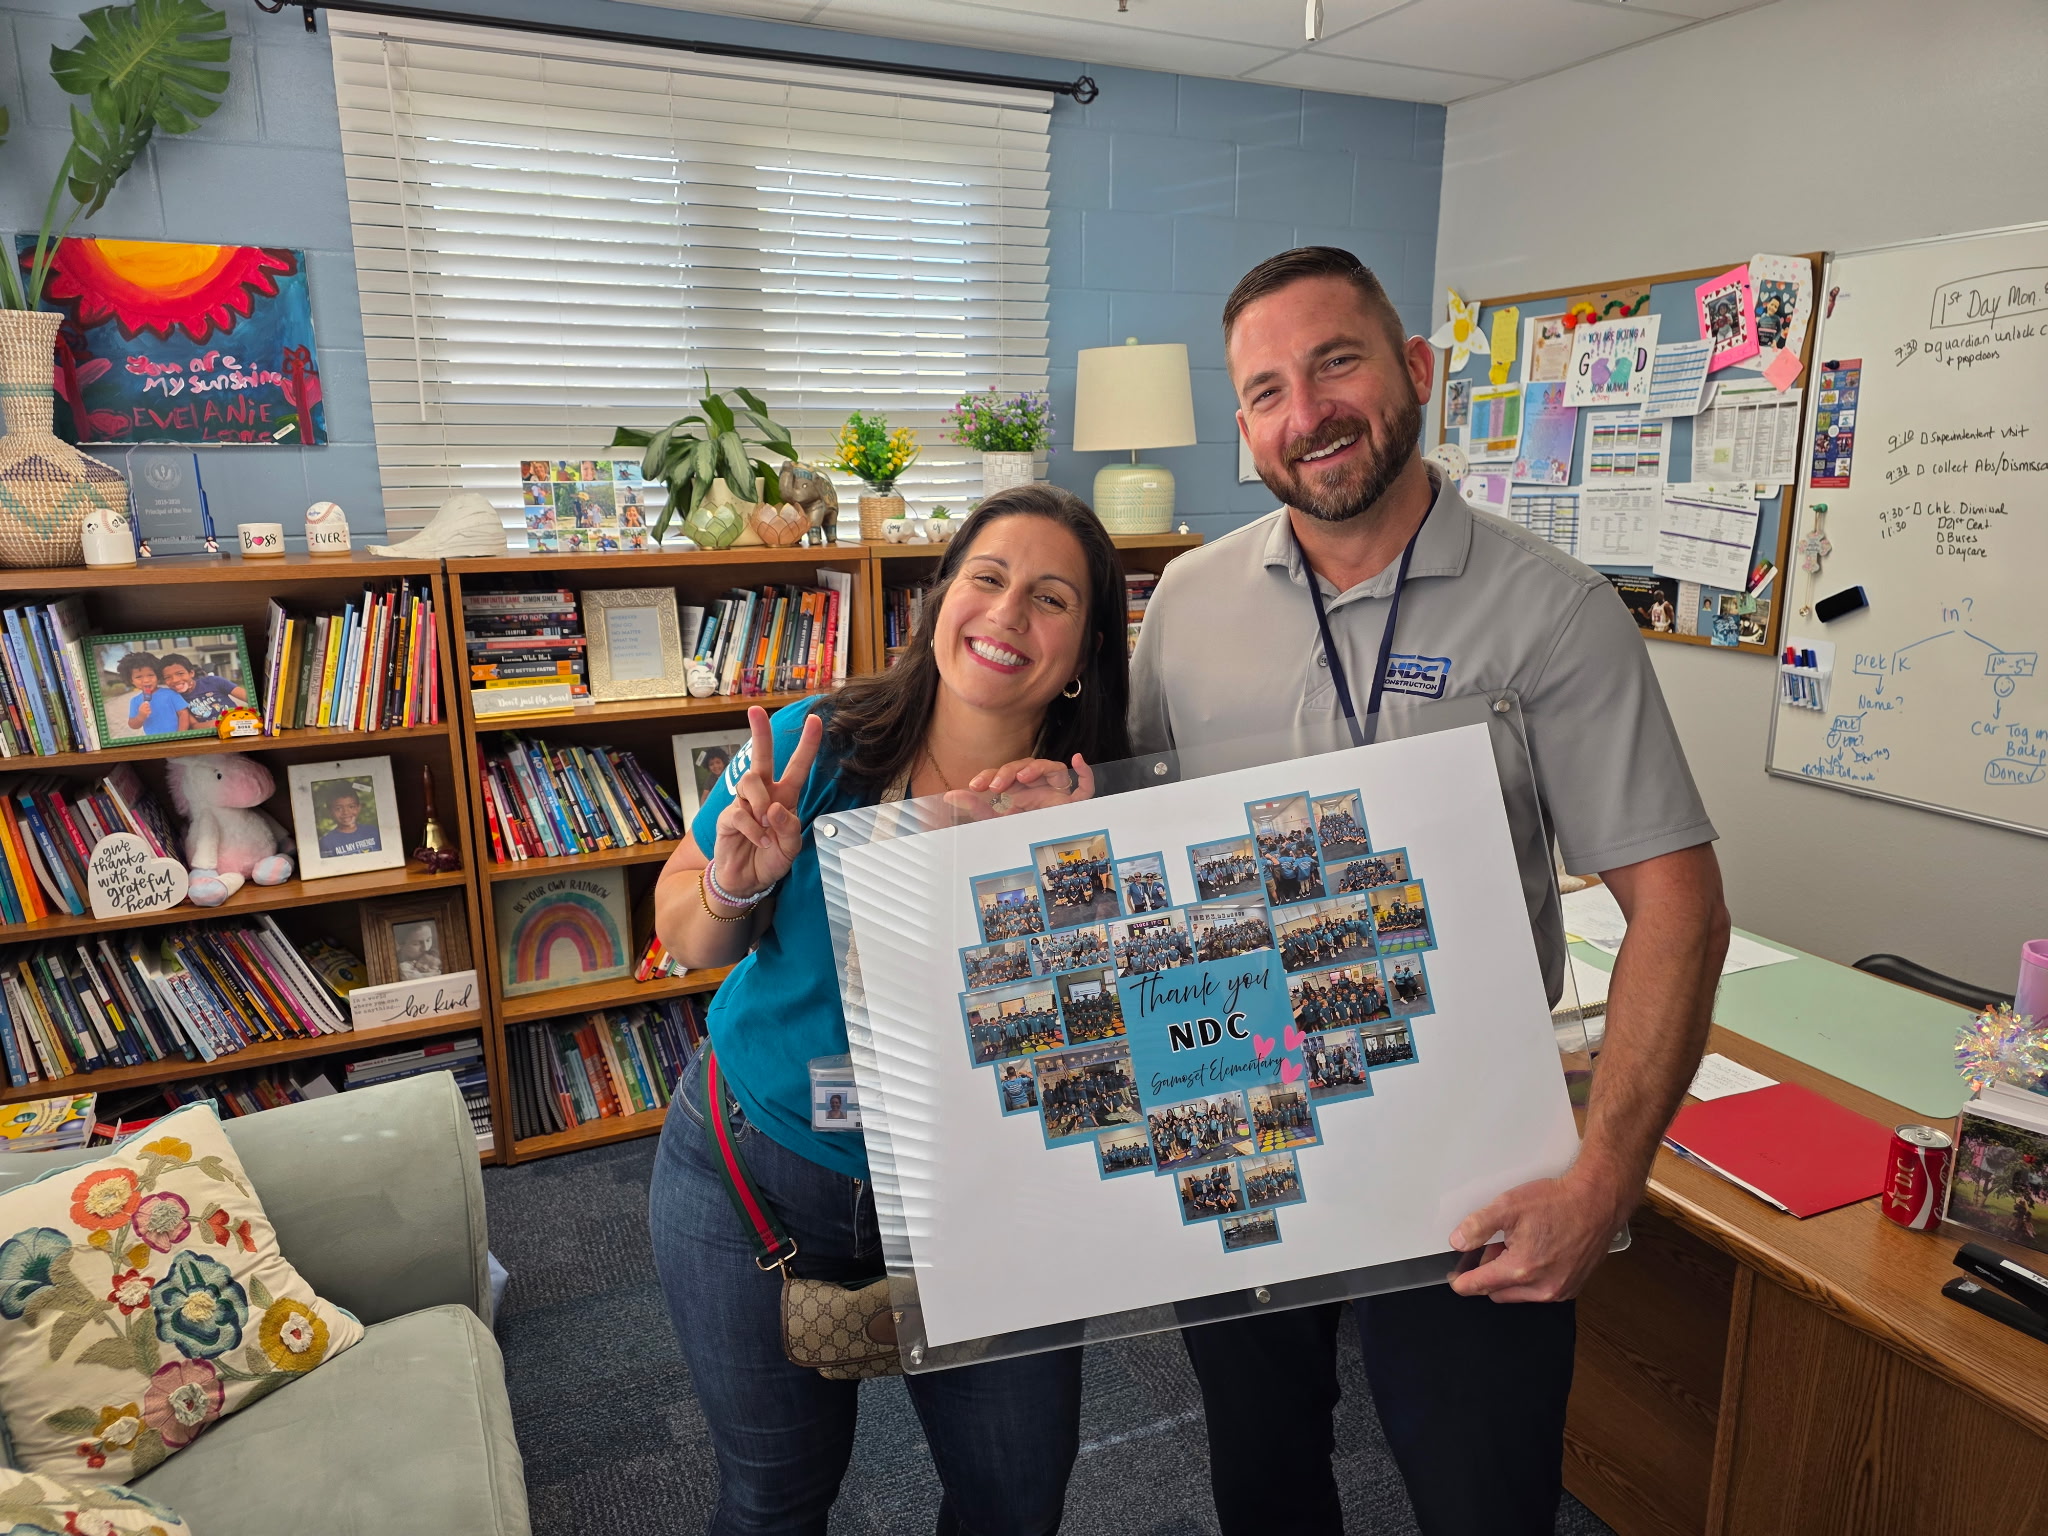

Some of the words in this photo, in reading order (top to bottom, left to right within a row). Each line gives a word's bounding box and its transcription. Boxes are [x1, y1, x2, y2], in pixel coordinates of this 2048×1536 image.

[1967, 290, 2000, 330] Day
[1589, 333, 1601, 343] YOU
[1616, 328, 1638, 340] DOING
[1935, 334, 1989, 362] guardian
[1995, 324, 2034, 341] unlock
[189, 351, 241, 373] are
[316, 532, 342, 543] EVER
[1949, 545, 1987, 562] Daycare
[1387, 662, 1440, 681] NDC
[1384, 679, 1437, 690] ONSTRUCTION
[1971, 721, 1999, 735] Car
[2006, 723, 2028, 745] Tag
[531, 754, 544, 770] 40
[102, 839, 131, 864] give
[335, 846, 346, 855] ALL
[347, 844, 355, 853] MY
[356, 837, 376, 850] FRIENDS
[38, 830, 49, 846] Solving
[50, 856, 62, 873] Behavior
[58, 871, 69, 889] Problems
[91, 852, 148, 875] thanks
[98, 868, 130, 889] with
[136, 865, 146, 874] a
[107, 868, 176, 908] grateful
[120, 887, 174, 913] heart
[512, 898, 526, 914] BE
[524, 886, 546, 904] YOUR
[548, 879, 567, 892] OWN
[570, 879, 611, 900] RAINBOW
[6, 990, 19, 1014] Behavior
[434, 984, 472, 1013] kind
[1129, 972, 1220, 1018] Thank
[1222, 968, 1270, 1014] you
[1167, 1012, 1250, 1053] NDC
[1151, 1063, 1209, 1095] Samoset
[1210, 1052, 1285, 1082] Elementary
